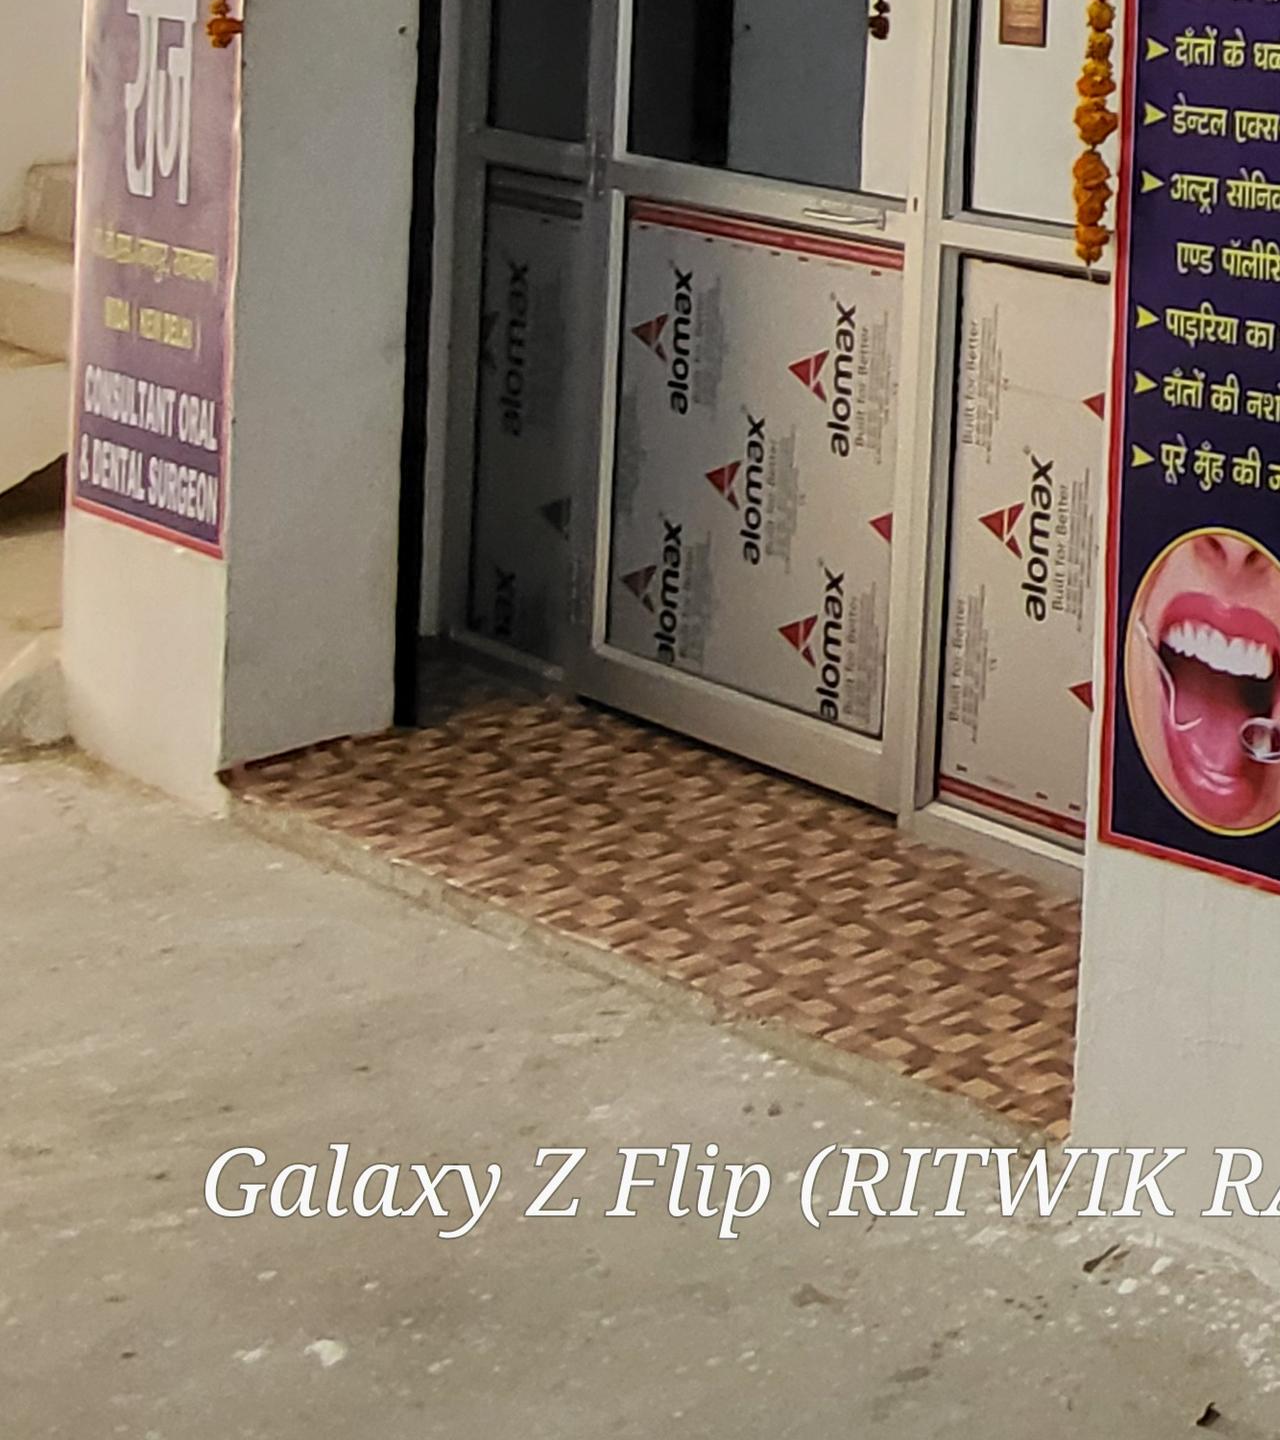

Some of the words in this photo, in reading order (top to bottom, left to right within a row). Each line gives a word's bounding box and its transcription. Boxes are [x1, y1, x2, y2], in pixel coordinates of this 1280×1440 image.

[1173, 93, 1227, 136] डेन्टल
[824, 300, 858, 458] alomax
[1163, 367, 1204, 409] दाँतों
[1211, 374, 1239, 415] की
[739, 415, 767, 566] alomax
[1021, 454, 1056, 623] alomax
